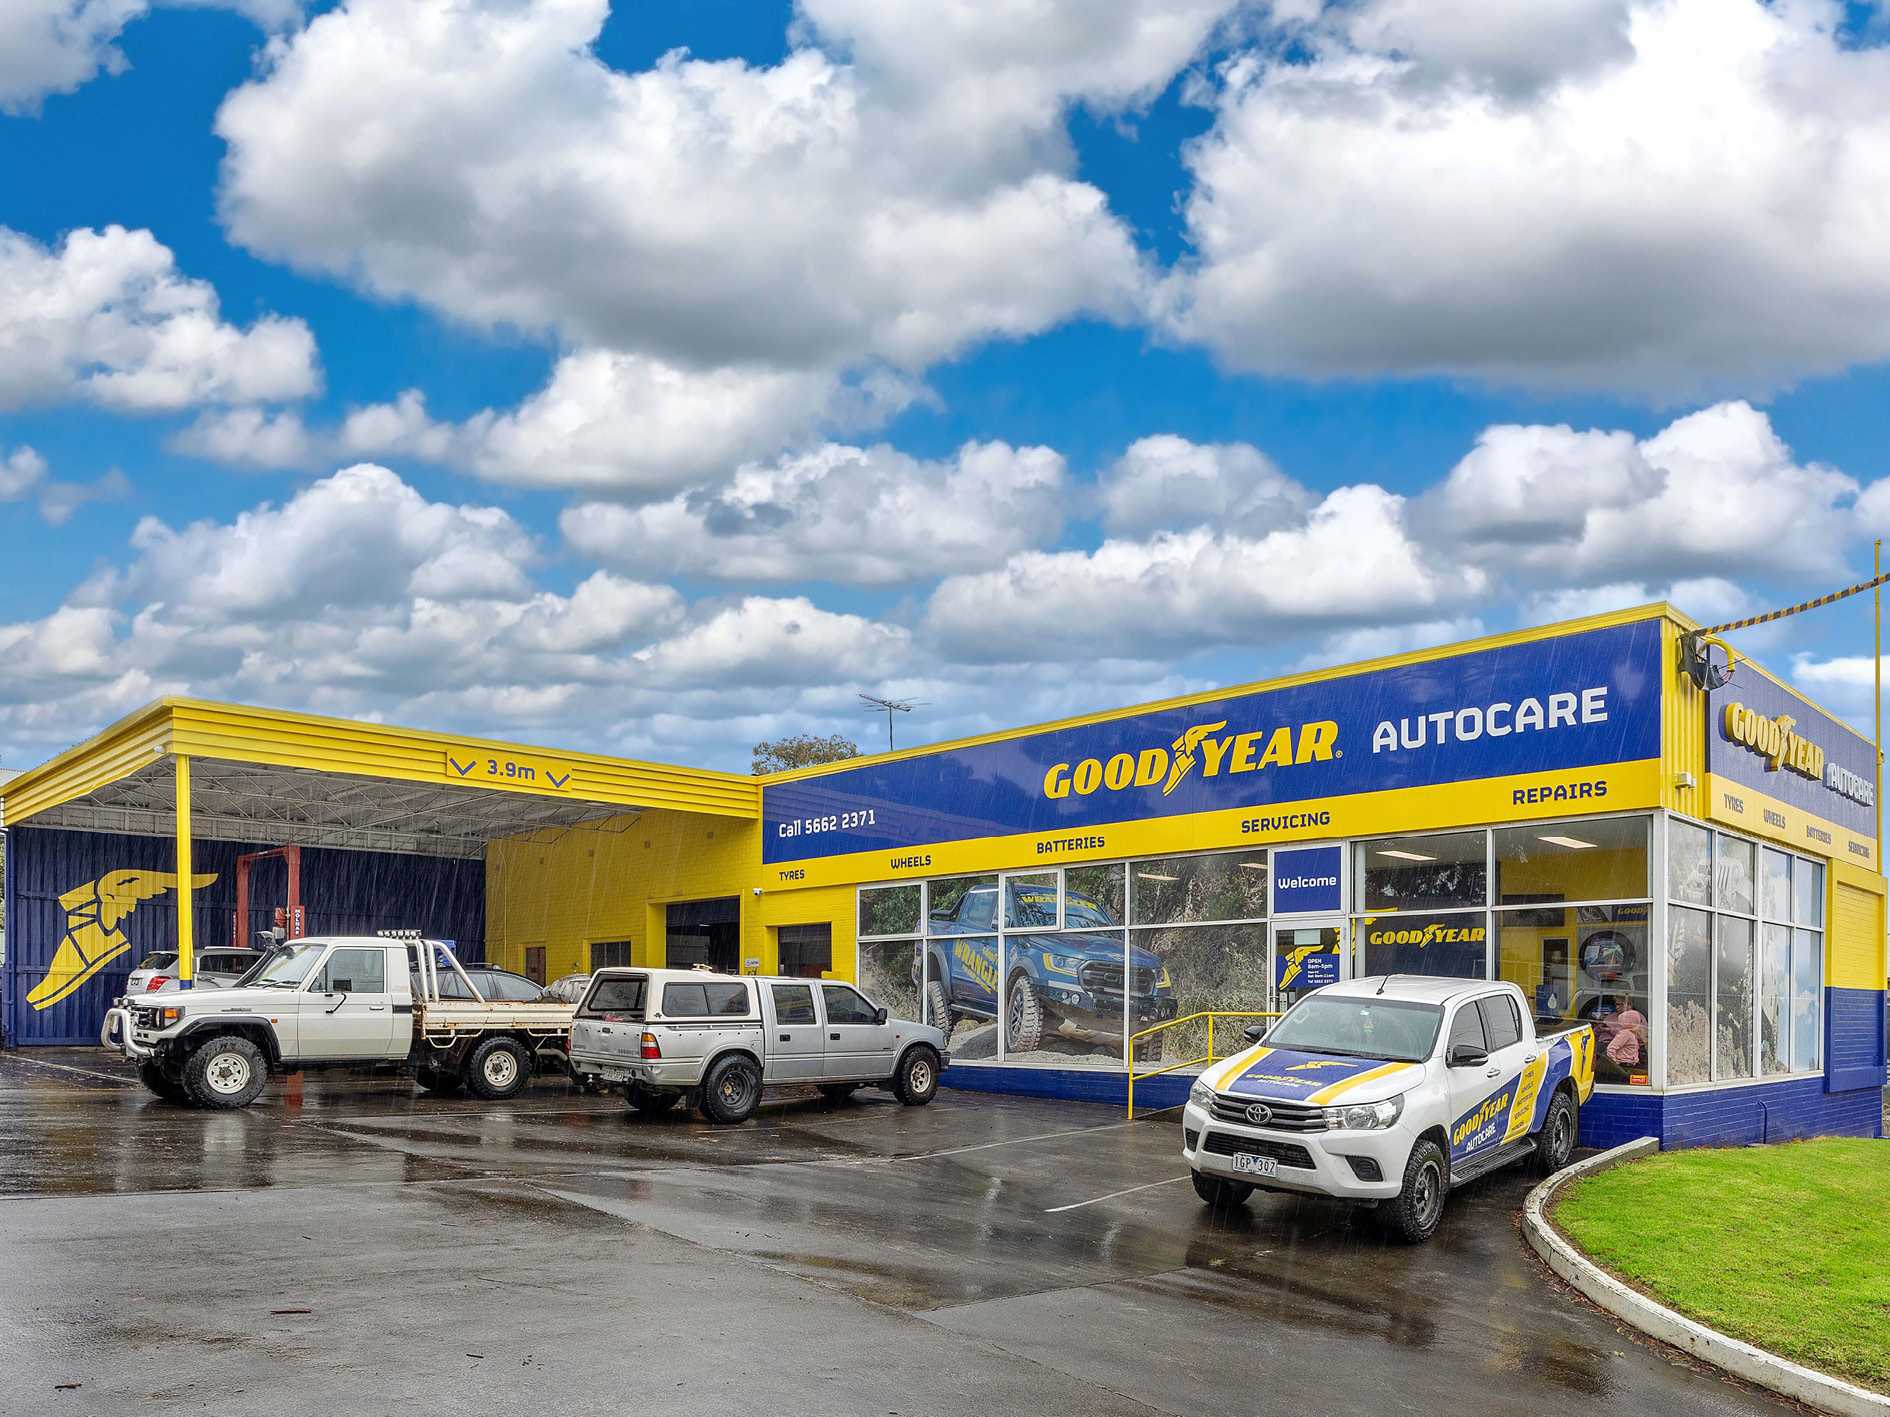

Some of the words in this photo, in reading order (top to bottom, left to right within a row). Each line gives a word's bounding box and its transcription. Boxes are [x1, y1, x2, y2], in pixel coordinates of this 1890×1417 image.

[1043, 720, 1339, 799] GOODYEAR
[1372, 686, 1609, 754] AUTOCARE
[1726, 702, 1825, 780] GOODYEAR
[1827, 763, 1874, 806] AUTOCARE
[487, 759, 535, 780] 3.9m
[779, 820, 801, 838] Call
[805, 815, 837, 834] 5662
[842, 809, 876, 829] 2371
[1724, 793, 1744, 815] TYRES
[1763, 808, 1786, 830] WHEELS
[779, 869, 805, 881] TYRES
[891, 855, 931, 870] WHEELS
[1037, 836, 1105, 854] BATTERIES
[1241, 811, 1330, 834] SERVICING
[1513, 780, 1608, 806] REPAIRS
[1278, 876, 1337, 889] Welcome
[1370, 926, 1486, 947] GOODYEAR
[1453, 1093, 1509, 1146] GOODYEAR
[1465, 1122, 1496, 1153] AUTOCARE
